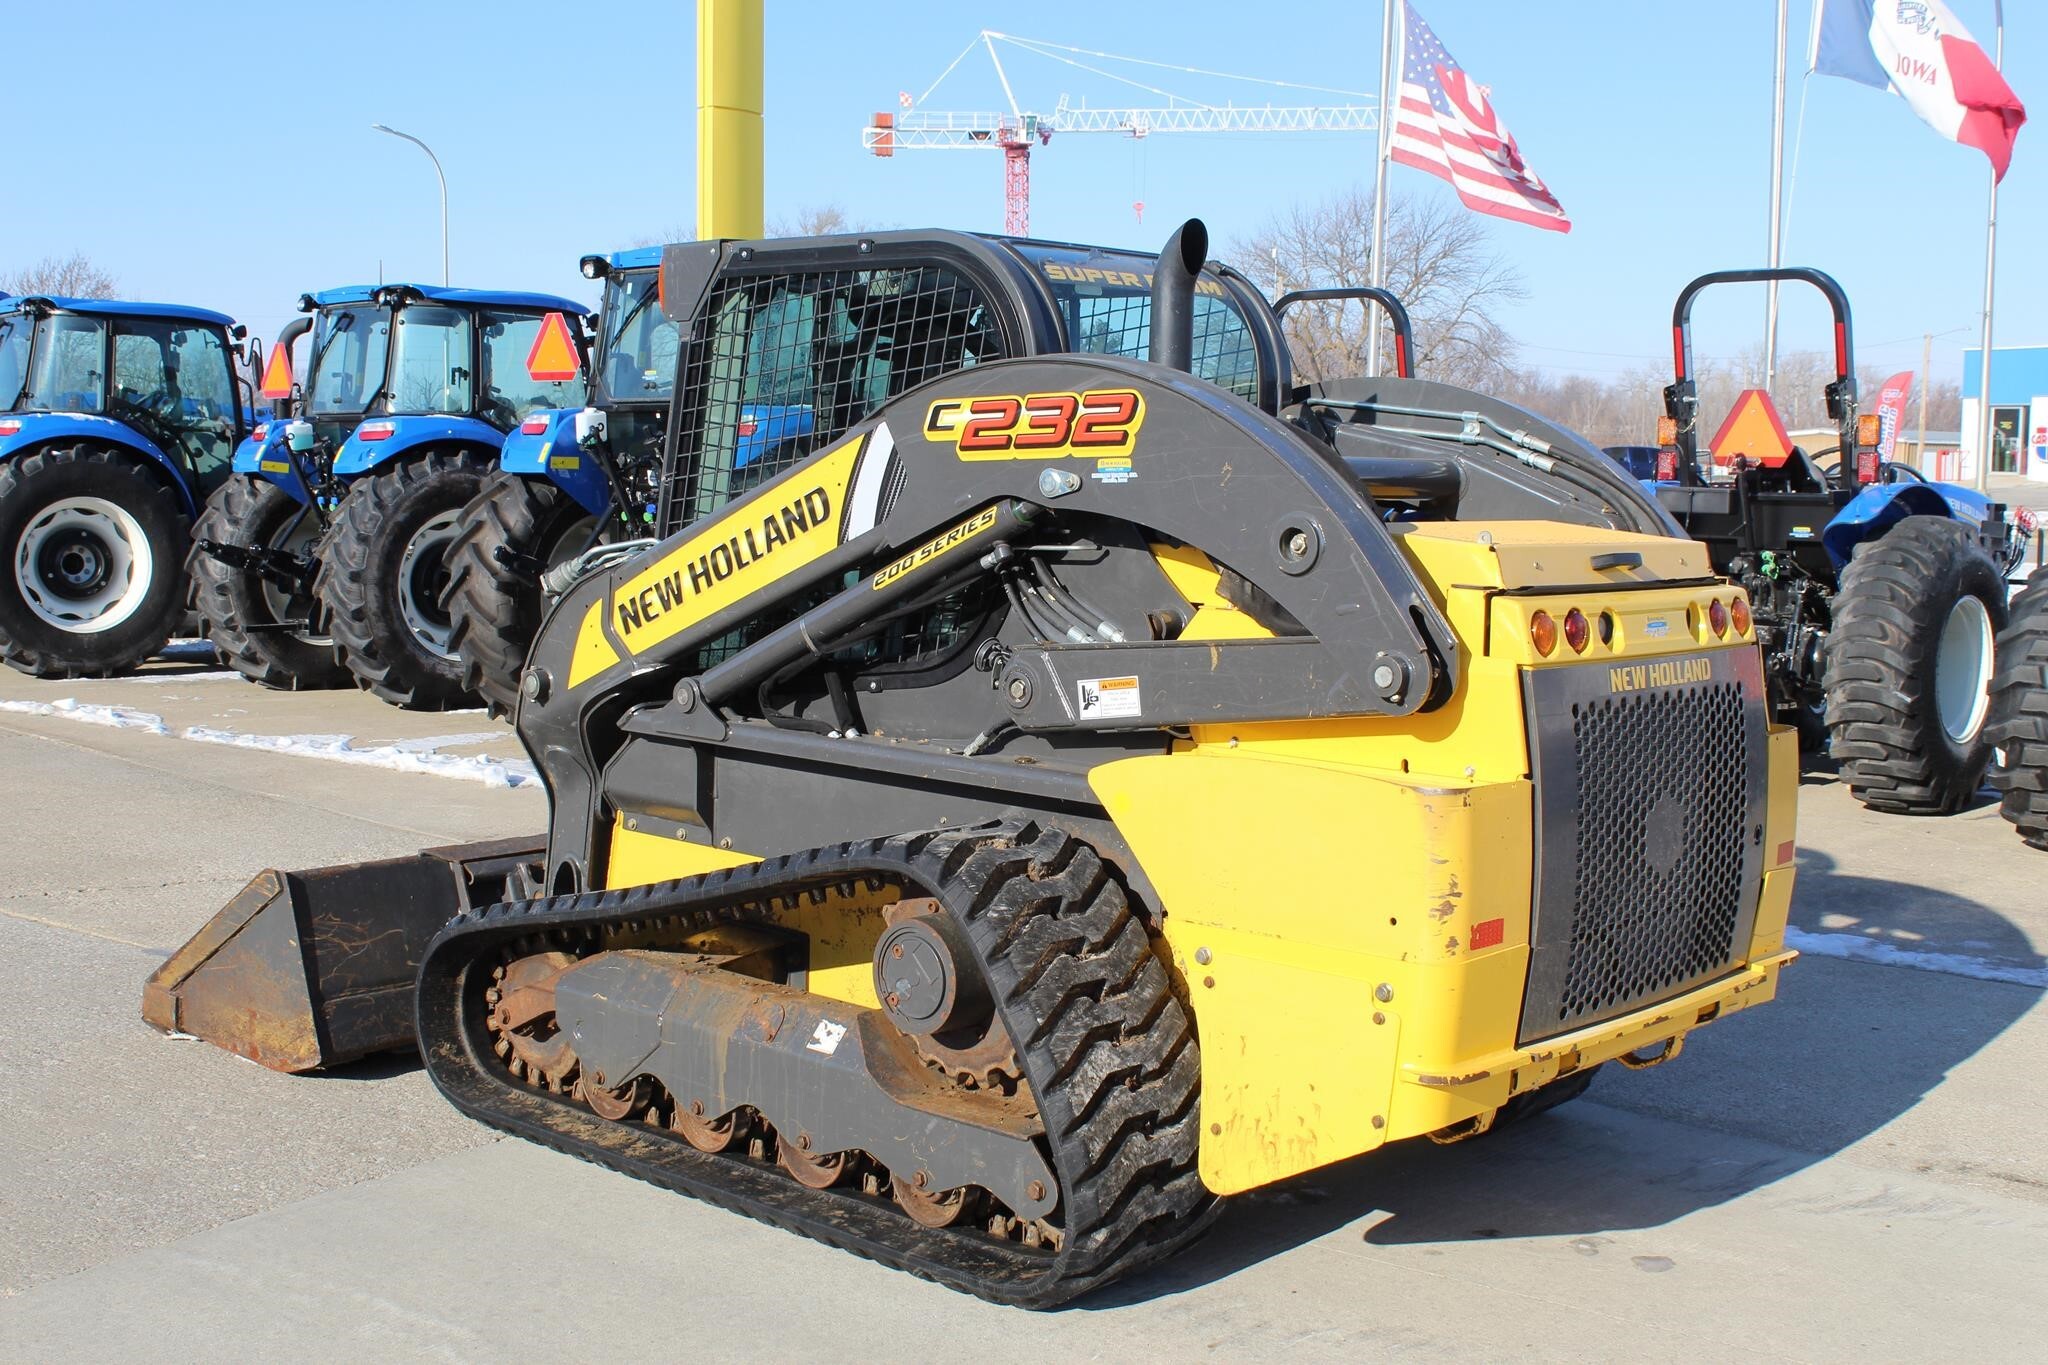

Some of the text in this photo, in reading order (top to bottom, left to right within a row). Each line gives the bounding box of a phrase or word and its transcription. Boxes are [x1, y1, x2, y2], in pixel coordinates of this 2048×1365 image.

[1896, 52, 1937, 85] IOWA
[1044, 264, 1142, 288] SUPER
[926, 392, 1140, 452] C232
[617, 486, 831, 636] NEW HOLLAND
[874, 510, 993, 587] 200 SERIES
[1609, 658, 1711, 693] NEW HOLLAND
